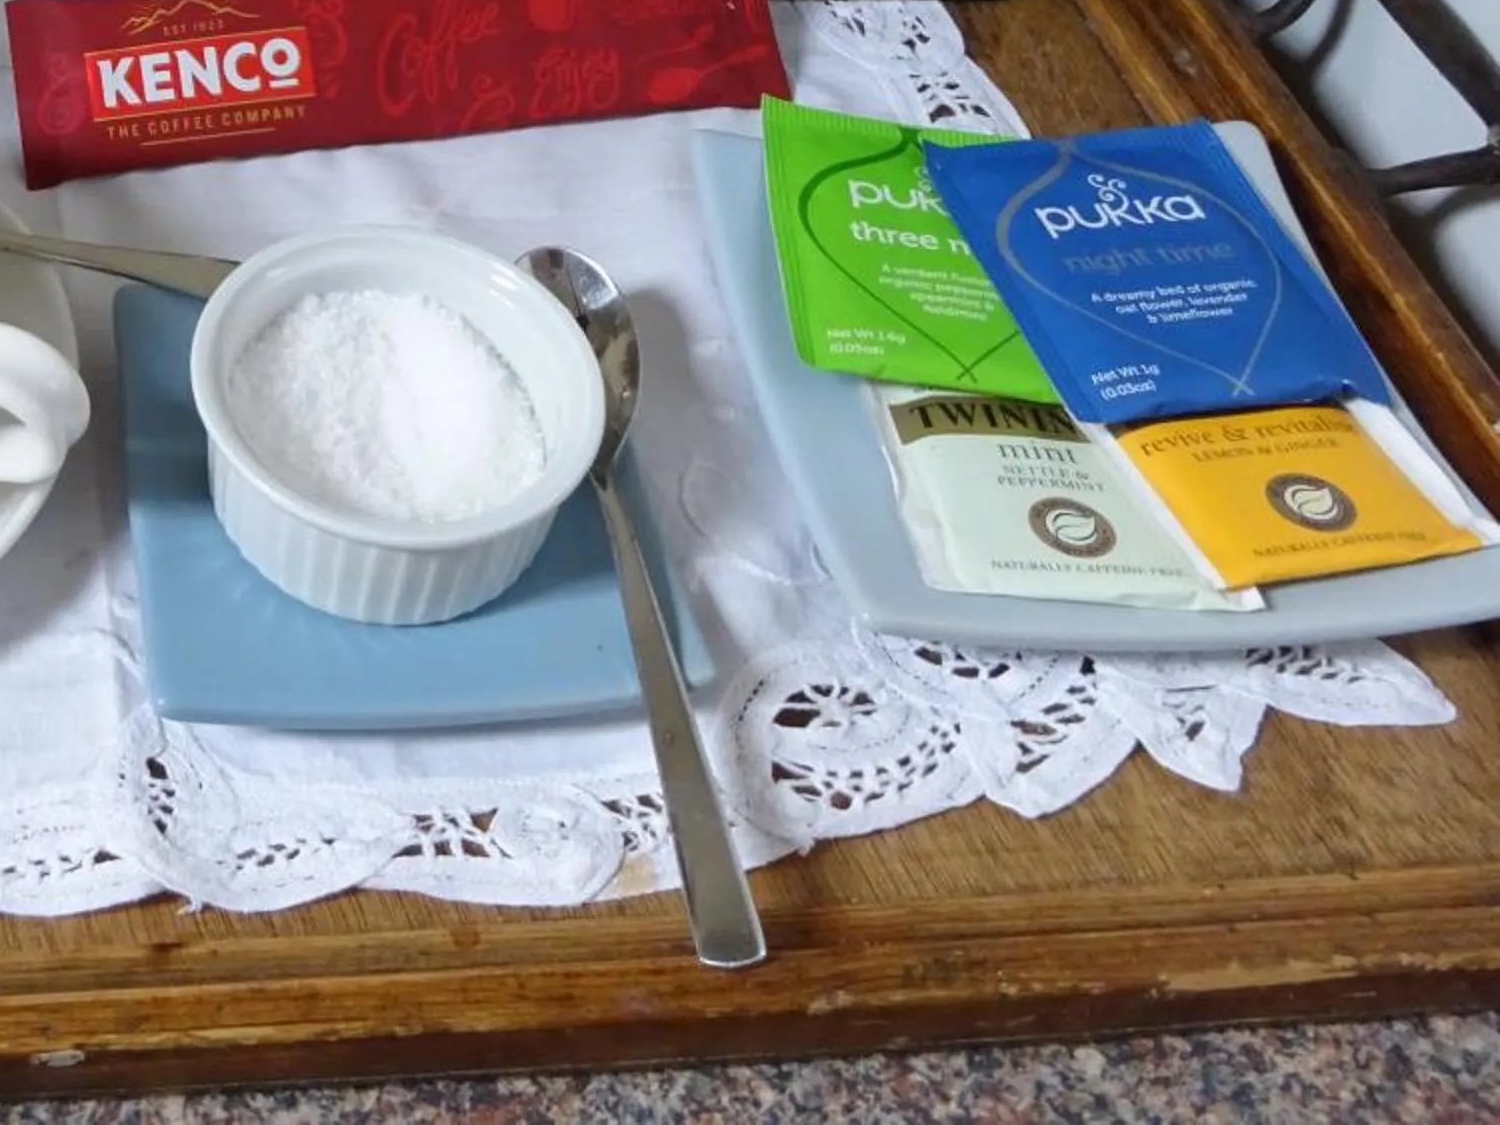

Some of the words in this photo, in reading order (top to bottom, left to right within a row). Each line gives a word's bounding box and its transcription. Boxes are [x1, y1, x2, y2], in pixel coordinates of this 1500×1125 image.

[96, 37, 302, 109] KENCO
[106, 124, 142, 141] THE
[147, 115, 218, 135] COFFEE
[220, 104, 308, 127] COMPANY
[847, 166, 952, 218] puk
[1033, 173, 1207, 241] pukka
[849, 219, 941, 252] three
[909, 400, 1078, 435] TWININ
[996, 439, 1078, 465] mint
[1139, 428, 1216, 458] revive
[1221, 424, 1250, 443] &
[996, 475, 1108, 493] PEPPERMINT
[990, 559, 1072, 574] NATURALLY
